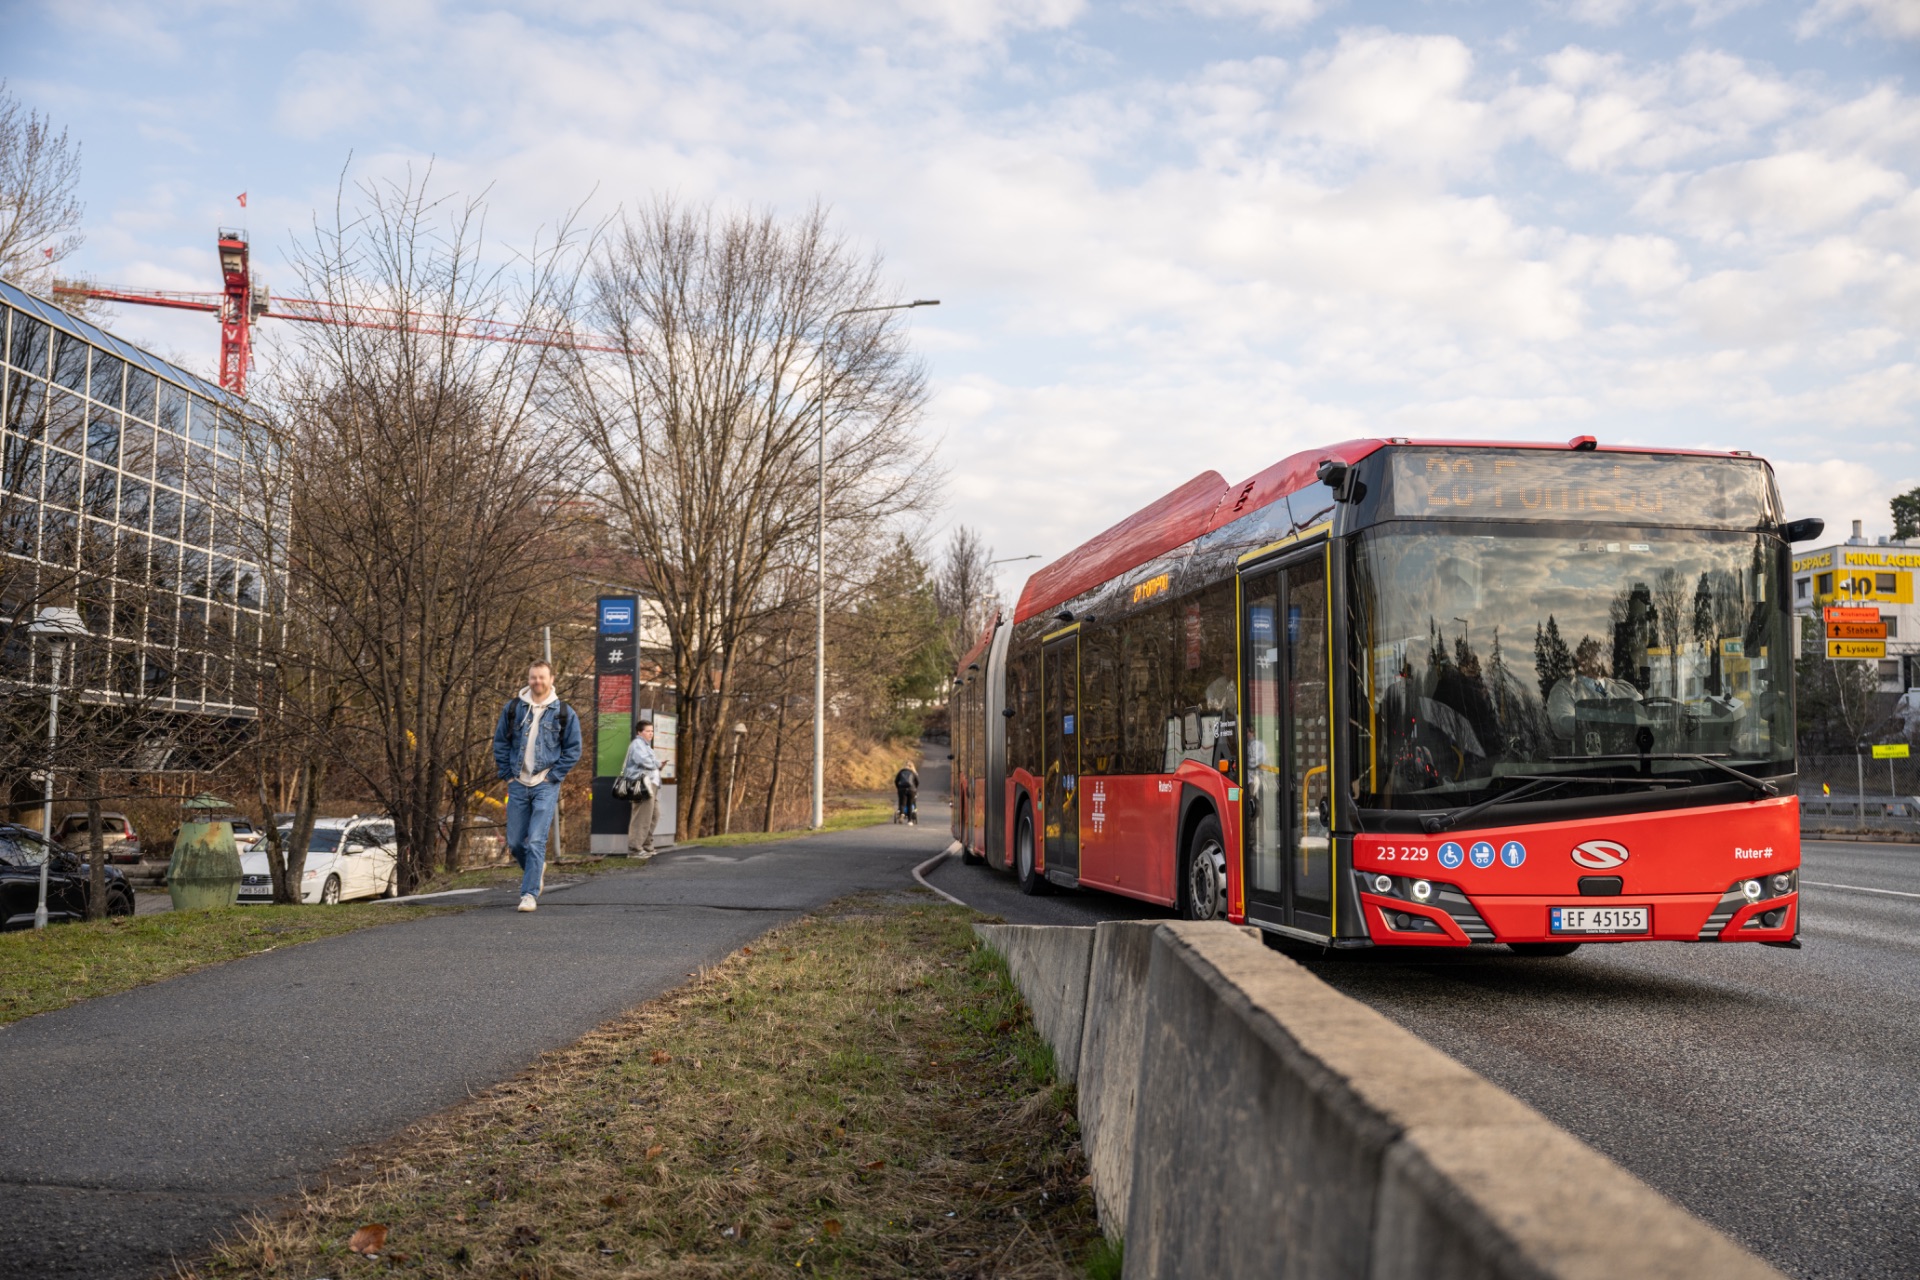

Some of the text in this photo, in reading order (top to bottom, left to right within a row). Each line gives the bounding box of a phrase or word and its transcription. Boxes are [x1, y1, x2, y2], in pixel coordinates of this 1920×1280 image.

[1801, 553, 1832, 570] SPACE
[1845, 552, 1920, 567] MINILAGER
[1846, 626, 1879, 634] Stabekk
[1846, 645, 1879, 654] Lysaker
[1377, 846, 1429, 861] 23 229
[1735, 847, 1773, 859] Ruter#
[1567, 911, 1585, 927] EF
[1592, 911, 1641, 927] 45155
